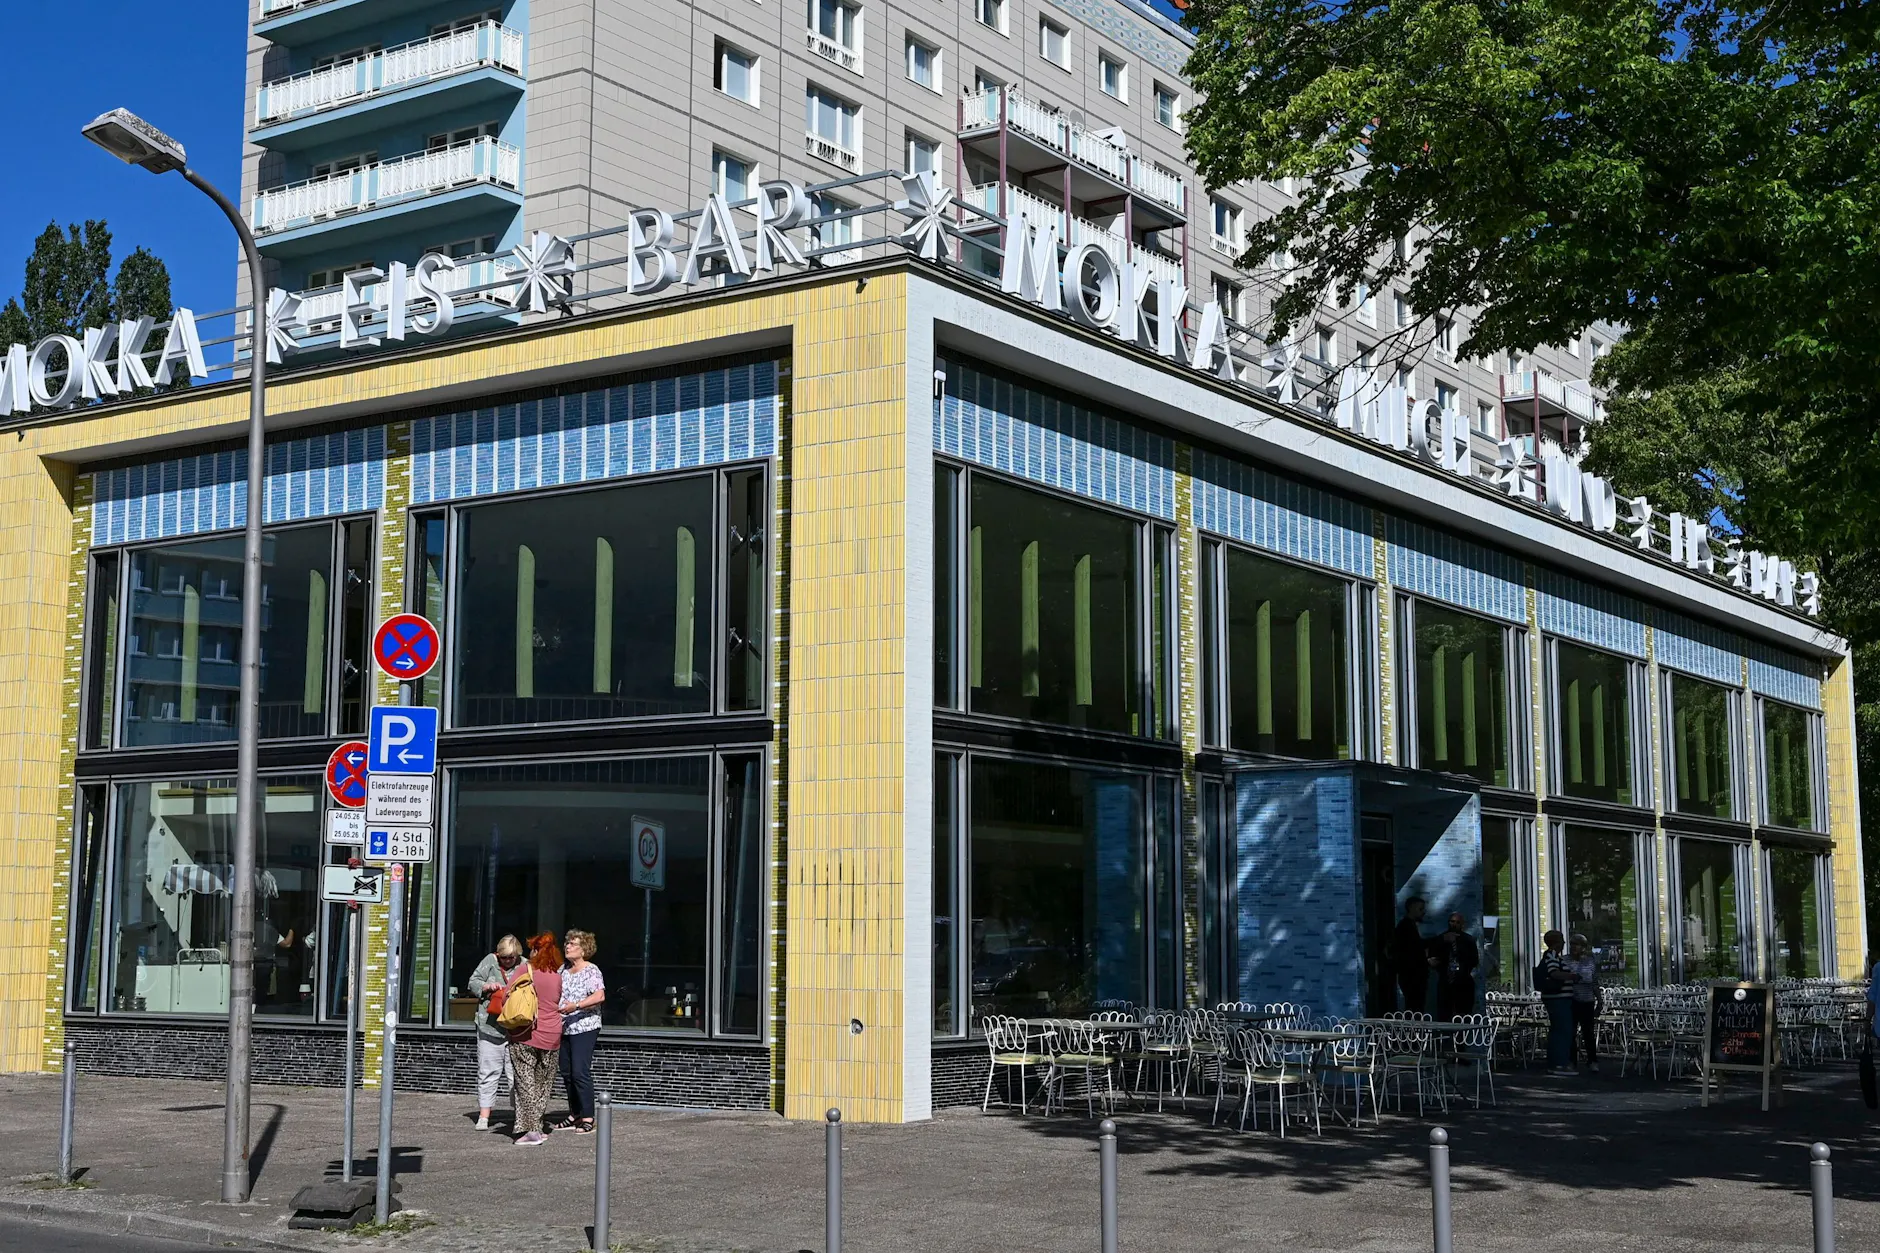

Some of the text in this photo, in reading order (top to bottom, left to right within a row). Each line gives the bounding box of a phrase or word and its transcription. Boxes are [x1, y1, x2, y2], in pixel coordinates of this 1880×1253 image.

[340, 252, 455, 349] EIS
[626, 180, 808, 295] BAR
[1001, 212, 1237, 382] MOKKA
[380, 715, 416, 764] P
[371, 781, 429, 792] Elektrofahrzeuge
[378, 795, 422, 803] während des
[335, 812, 360, 820] 24.05.26
[375, 807, 423, 818] Ladevorgangs
[334, 830, 359, 838] 25.05.26
[392, 831, 425, 843] 4 Std.
[1717, 1015, 1755, 1029] MILCH
